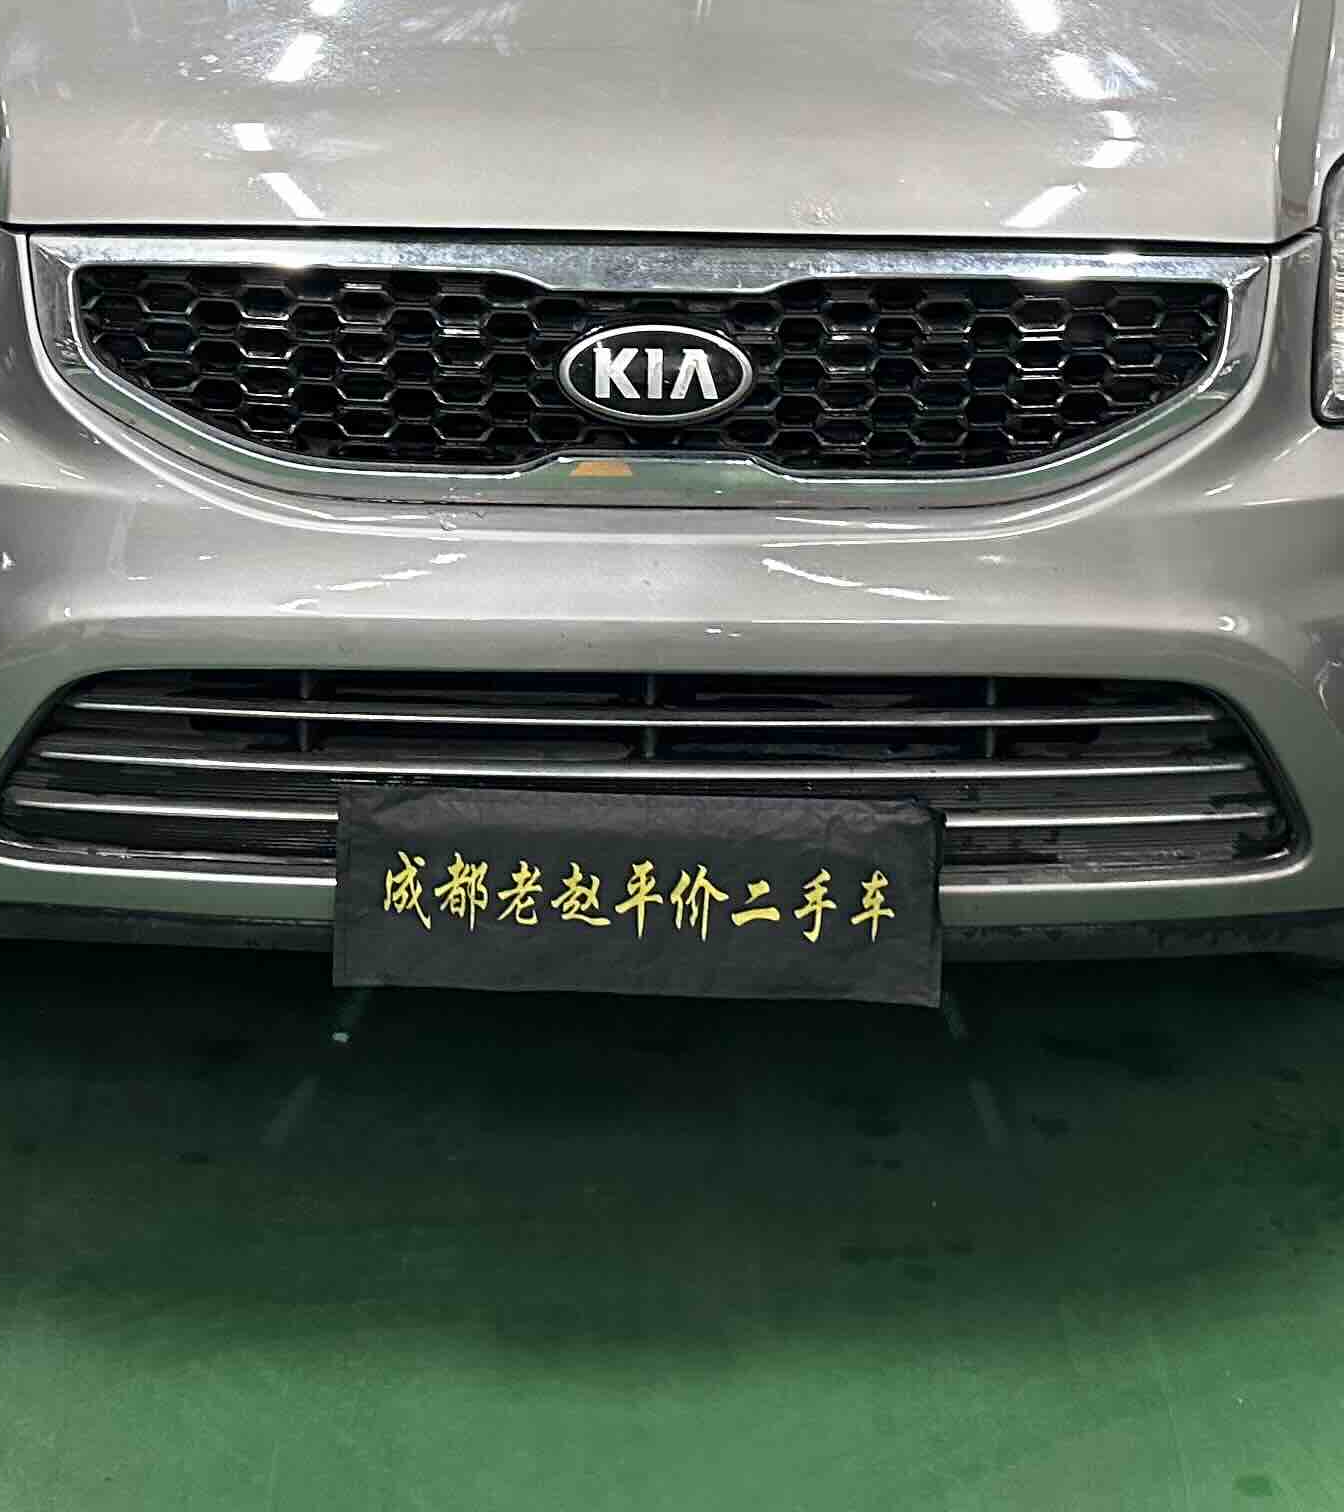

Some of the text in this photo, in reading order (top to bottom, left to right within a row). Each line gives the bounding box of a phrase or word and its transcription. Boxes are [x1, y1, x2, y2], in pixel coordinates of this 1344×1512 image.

[593, 347, 719, 400] KIA
[382, 850, 896, 943] 成都老赵平价二手车
